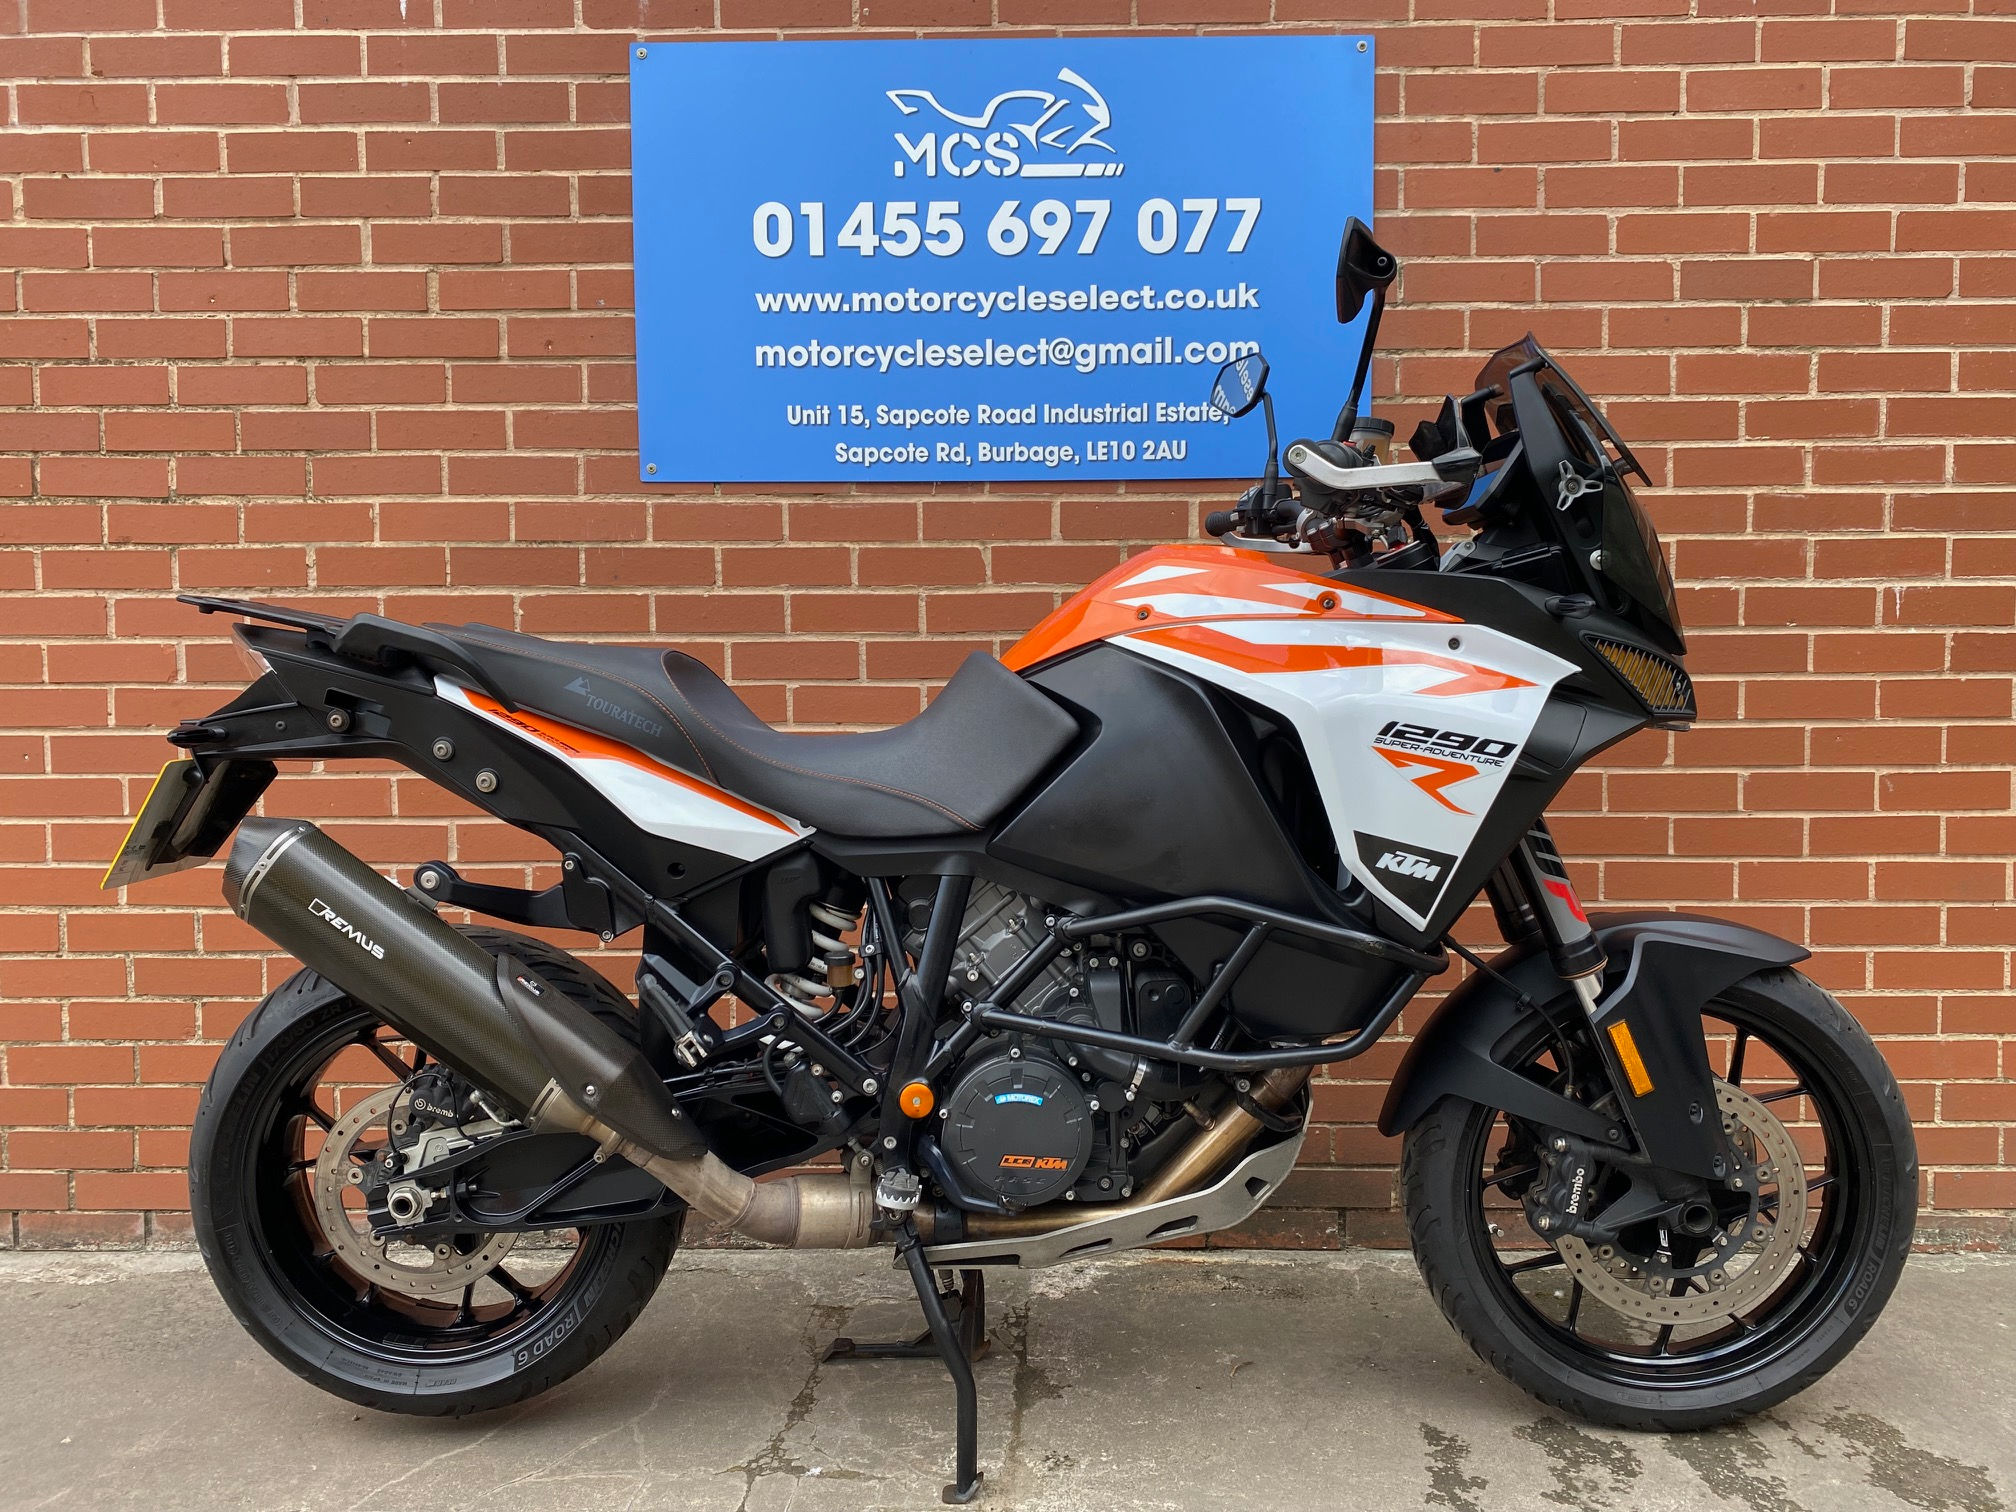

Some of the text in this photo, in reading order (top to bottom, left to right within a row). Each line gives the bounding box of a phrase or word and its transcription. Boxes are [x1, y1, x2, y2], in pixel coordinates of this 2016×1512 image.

[894, 132, 1021, 178] MCS
[752, 198, 1262, 258] 01455 697 077
[754, 283, 1260, 319] www.motorcycleselect.co.uk
[755, 336, 1261, 372] motorcycleselect@gmail.com
[786, 401, 1229, 429] Unit 15, Sapcote Road Industrial Estate,
[835, 440, 1188, 467] Sapcote Rd, Burbage, LE10 2AU
[585, 694, 664, 738] TOURATECH
[1373, 736, 1505, 768] SUPER-ADVENTURE
[1376, 720, 1519, 759] 1290
[1375, 850, 1442, 882] KTM
[312, 899, 385, 960] REMUS
[1034, 1157, 1068, 1170] KTM
[1565, 1167, 1585, 1215] brembo
[533, 1309, 575, 1356] ROAD
[517, 1351, 529, 1367] 6
